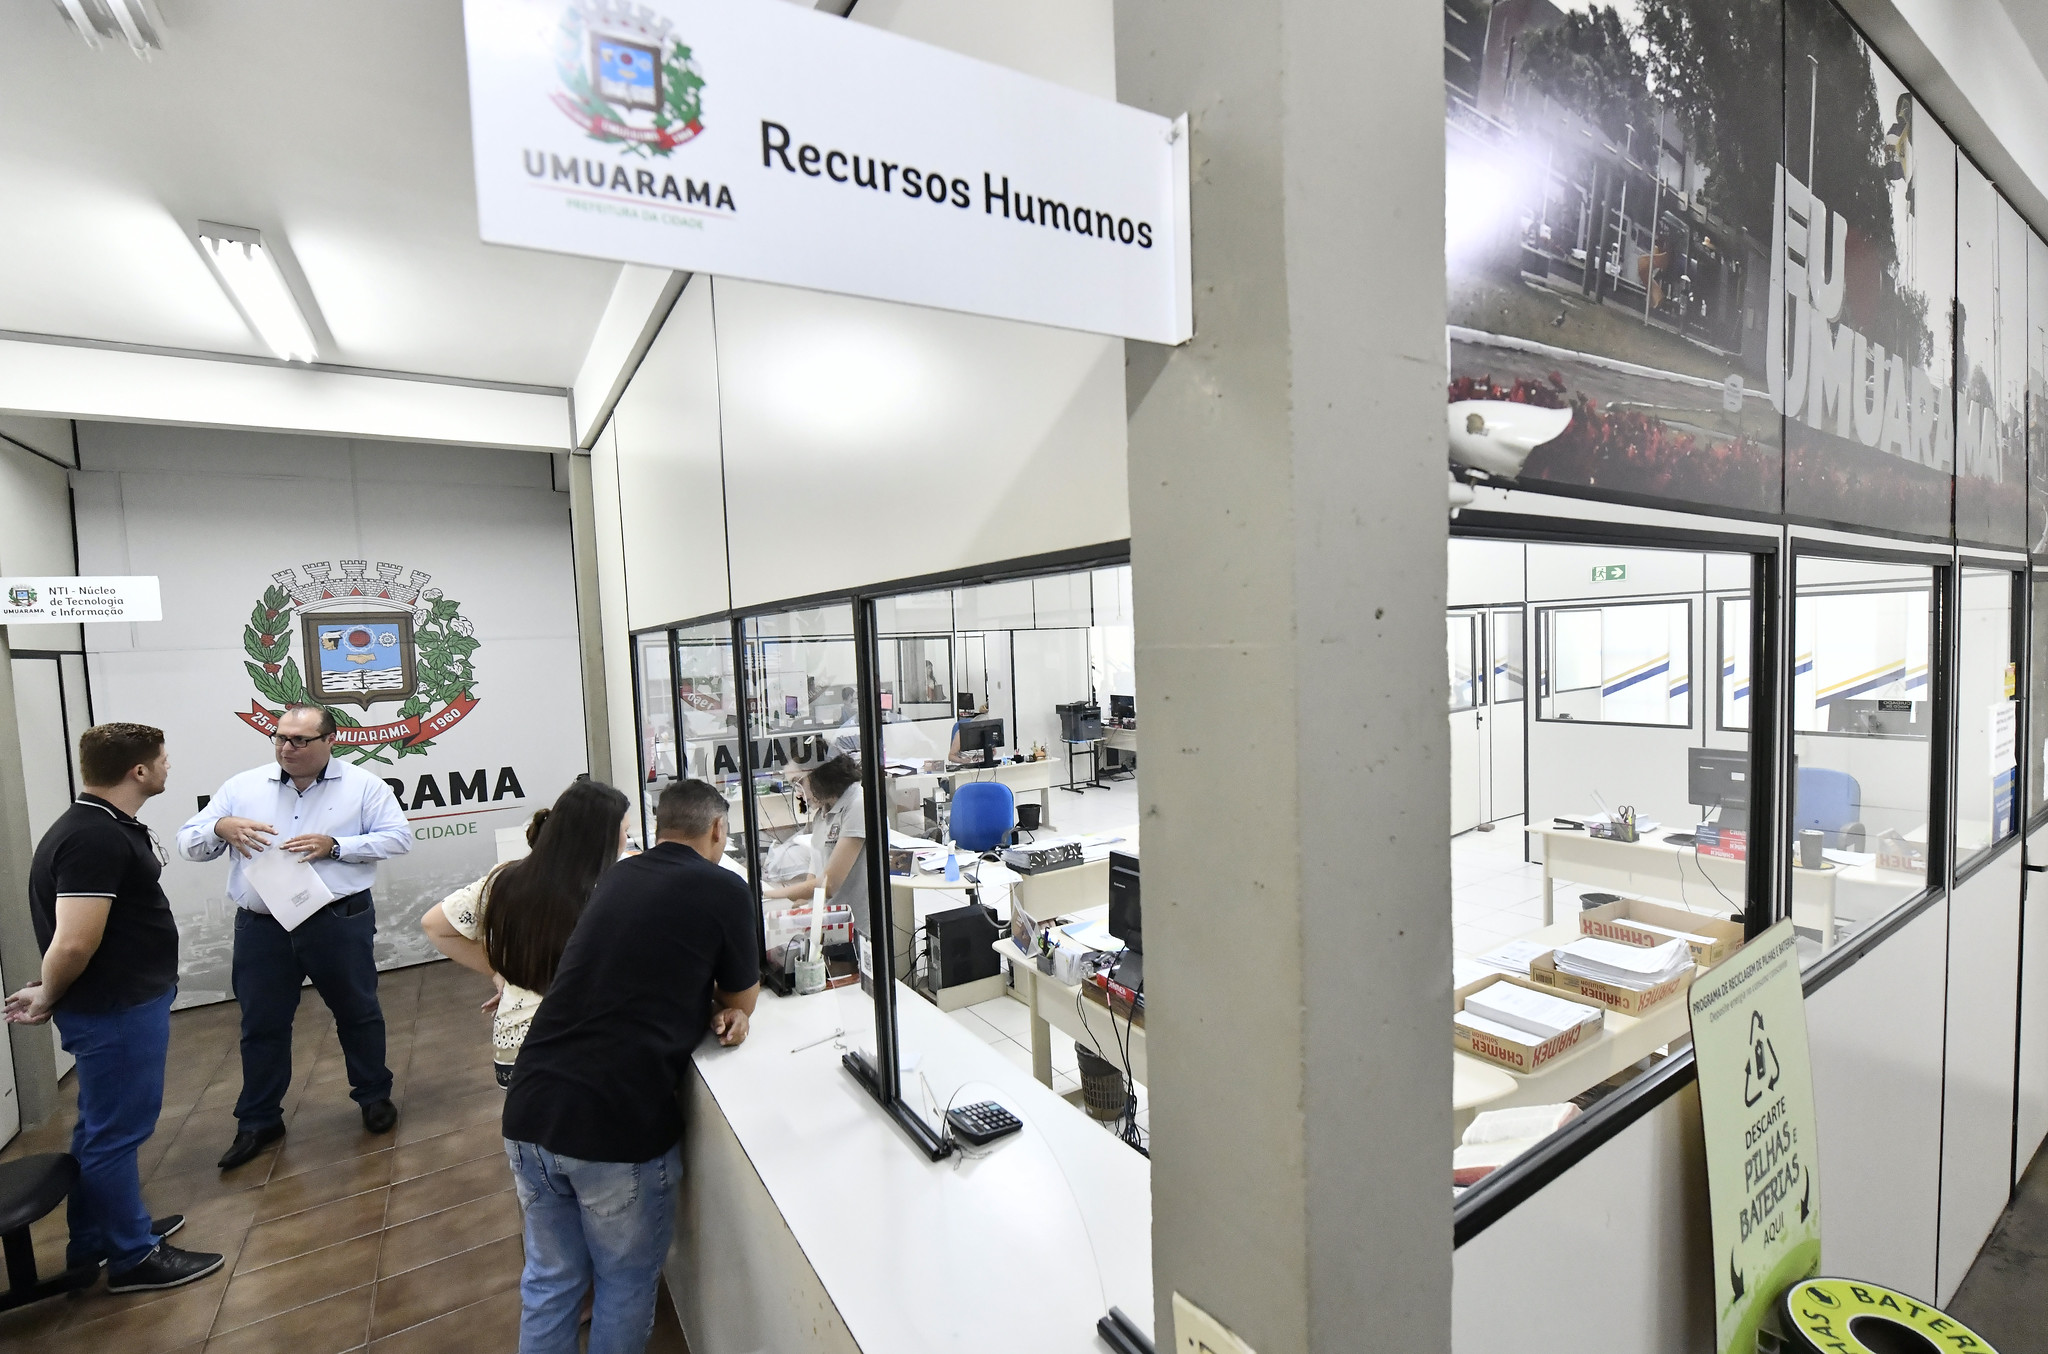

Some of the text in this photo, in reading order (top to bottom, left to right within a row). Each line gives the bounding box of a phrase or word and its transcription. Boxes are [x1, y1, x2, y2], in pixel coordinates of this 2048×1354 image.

[523, 149, 737, 212] UMUARAMA
[760, 119, 1153, 249] Recursos Humanos
[565, 197, 640, 220] PREFEITURA
[661, 213, 705, 230] CIDADE
[1769, 162, 1848, 323] EU
[1766, 284, 2003, 484] UMUARAMA
[49, 586, 68, 596] NTI
[79, 585, 116, 595] Núcleo
[50, 596, 124, 608] de Tecnologia
[51, 607, 124, 618] e Informação
[250, 711, 268, 726] 25
[335, 724, 411, 743] MUARAMA
[429, 707, 462, 732] 1960
[382, 766, 526, 811] RAMA
[414, 821, 478, 841] CIDADE
[1580, 986, 1630, 1009] CHAMEX
[1692, 988, 1722, 1015] PROGRAMA
[1721, 981, 1729, 996] DE
[1728, 963, 1757, 990] RECICLAGEM
[1471, 1030, 1499, 1046] Solution
[1471, 1037, 1524, 1067] CHAMEX
[1531, 1024, 1582, 1068] CHAMEX
[1745, 1095, 1787, 1150] DESCARTE
[1744, 1120, 1798, 1194] PILHAS E
[1739, 1152, 1800, 1244] BATERIAS
[1763, 1211, 1785, 1249] AQUI
[1849, 1286, 1978, 1354] BATER
